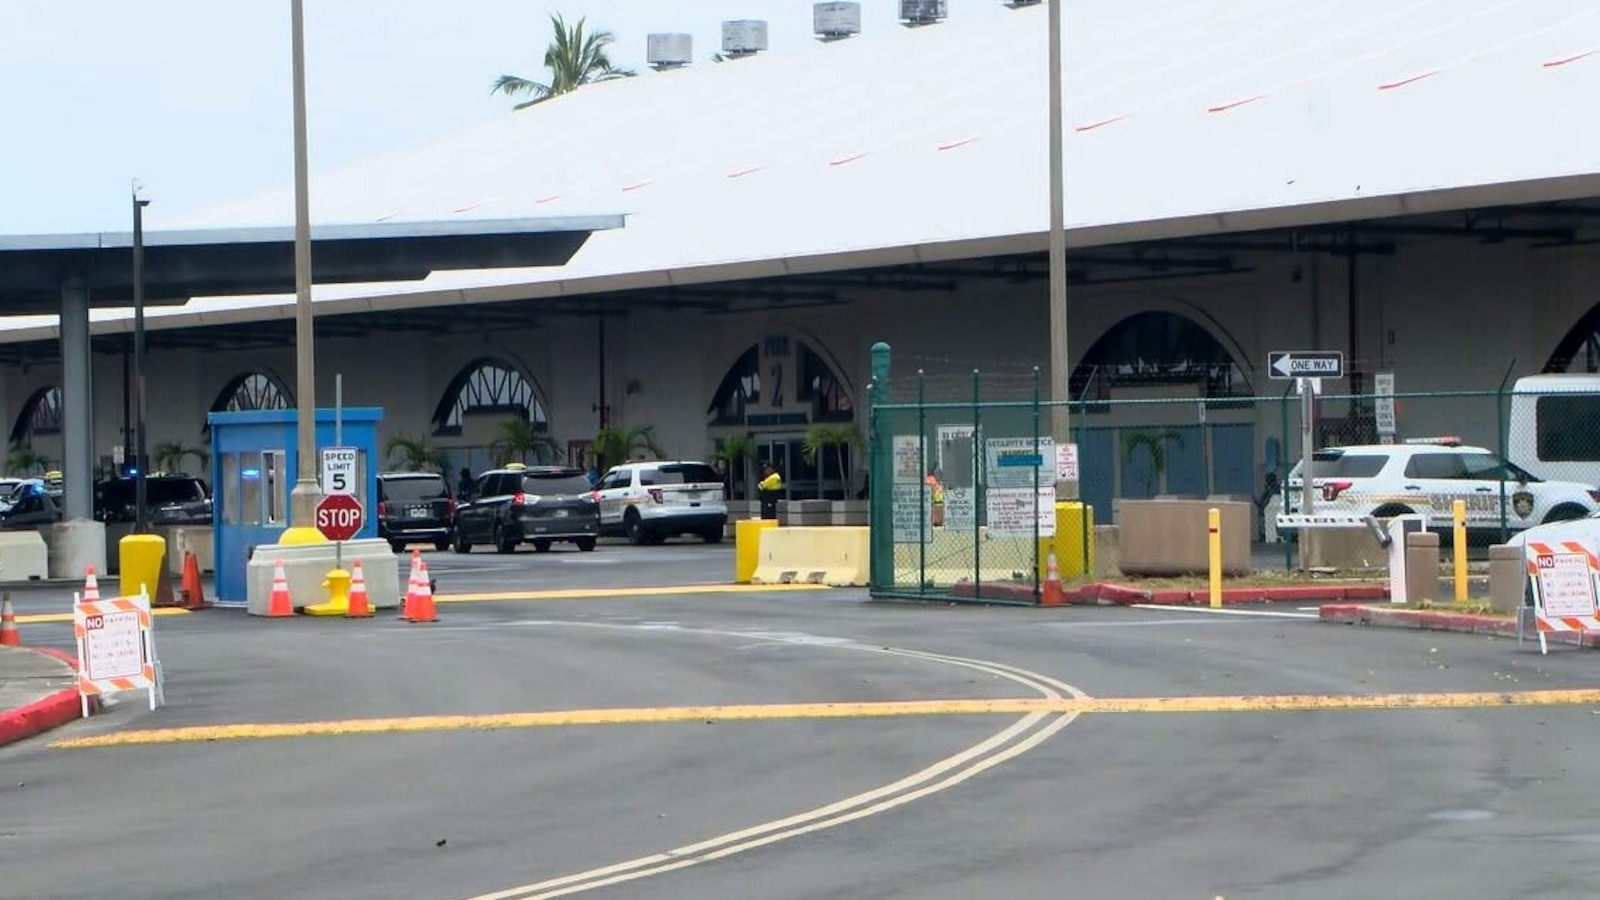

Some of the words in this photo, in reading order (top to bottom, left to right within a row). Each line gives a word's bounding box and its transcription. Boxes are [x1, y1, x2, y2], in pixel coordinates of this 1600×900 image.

[1291, 360, 1310, 370] ONE
[1313, 360, 1334, 370] WAY
[770, 363, 784, 408] 2
[325, 453, 354, 461] SPEED
[328, 463, 351, 471] LIMIT
[333, 473, 346, 490] 5
[318, 509, 360, 527] STOP
[1538, 557, 1554, 568] NO
[86, 617, 103, 628] NO
